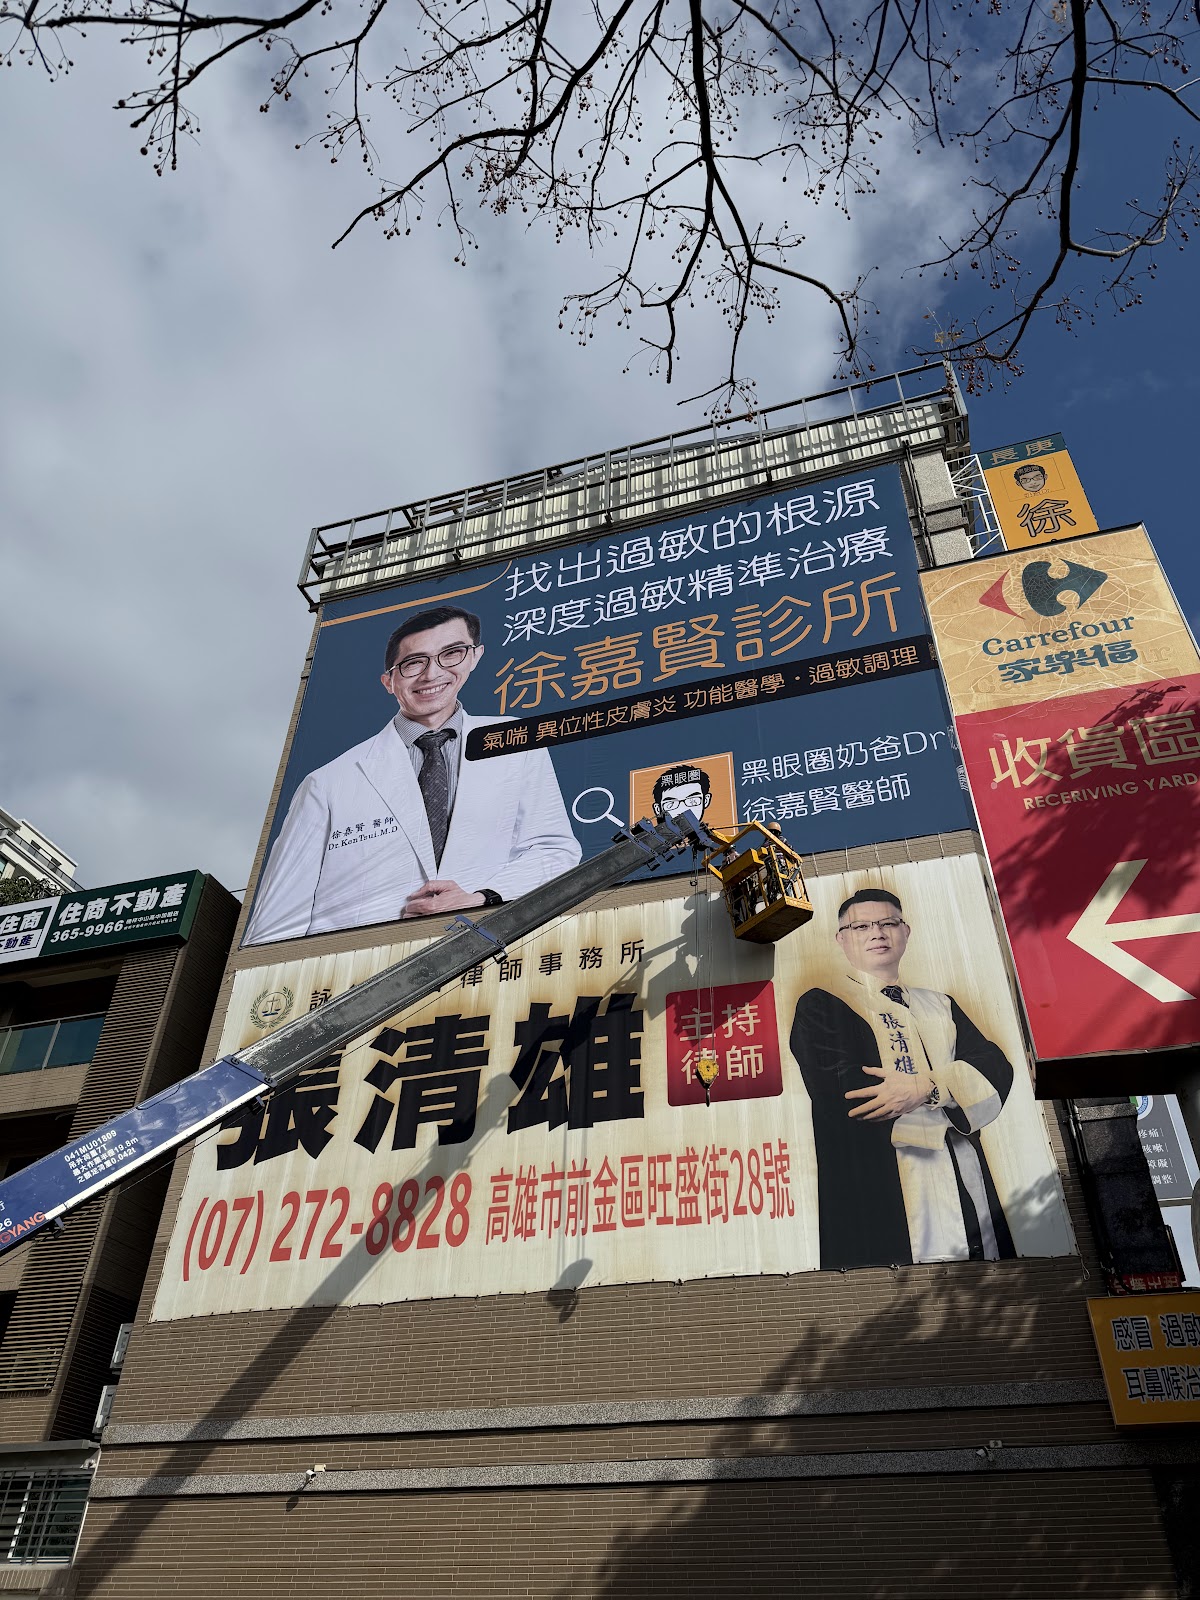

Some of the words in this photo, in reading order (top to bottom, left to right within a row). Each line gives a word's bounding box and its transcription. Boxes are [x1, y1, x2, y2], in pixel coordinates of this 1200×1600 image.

[505, 478, 880, 601] 找出過敏的根源
[1017, 498, 1077, 538] 徐
[502, 526, 894, 646] 深度過敏精準治療
[494, 571, 901, 715] 徐嘉賢診所
[982, 616, 1135, 656] Carrefour
[998, 639, 1139, 683] 家樂福
[482, 724, 528, 751] 氣喘
[535, 696, 677, 741] 異位性皮膚炎
[989, 709, 1200, 788] 收貨區
[661, 769, 701, 787] 黑眼圈
[742, 773, 912, 824] 徐嘉賢醫師
[1023, 781, 1139, 810] RECERIVING
[1143, 772, 1198, 791] YARD
[0, 911, 44, 935] 住商
[58, 883, 187, 927] 住商不動產
[50, 920, 124, 943] 365-9966
[680, 1002, 761, 1041] 主持
[879, 1012, 919, 1075] 張清雄
[64, 1129, 117, 1162] 041MU01809
[183, 1190, 264, 1281] (07)
[269, 1172, 471, 1263] 272-8828
[486, 1138, 794, 1245] 高雄市前金區旺盛街28號
[1112, 1316, 1154, 1352] 感冒
